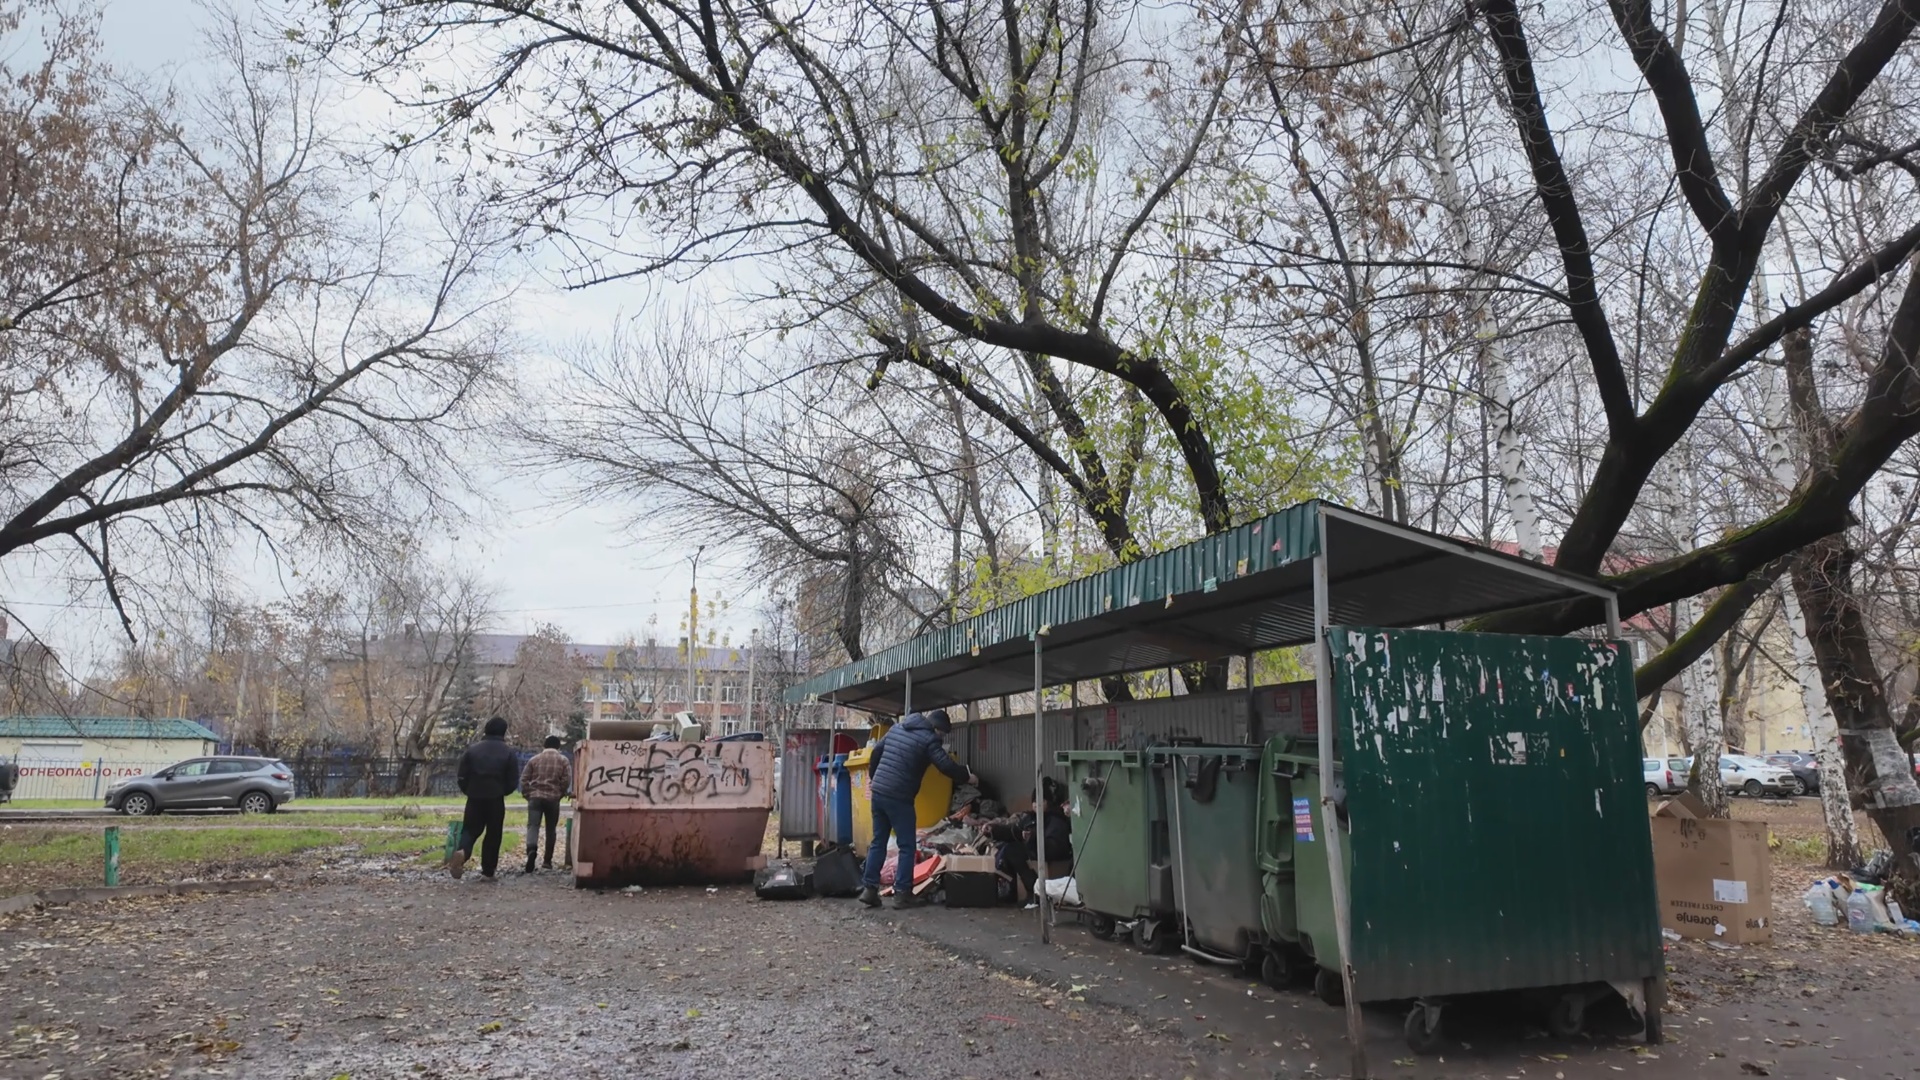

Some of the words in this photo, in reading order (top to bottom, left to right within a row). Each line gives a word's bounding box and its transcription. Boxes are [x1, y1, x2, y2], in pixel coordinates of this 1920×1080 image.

[1670, 900, 1700, 909] FREEZER
[1702, 903, 1724, 912] CHEST
[1676, 912, 1719, 926] gorenje
